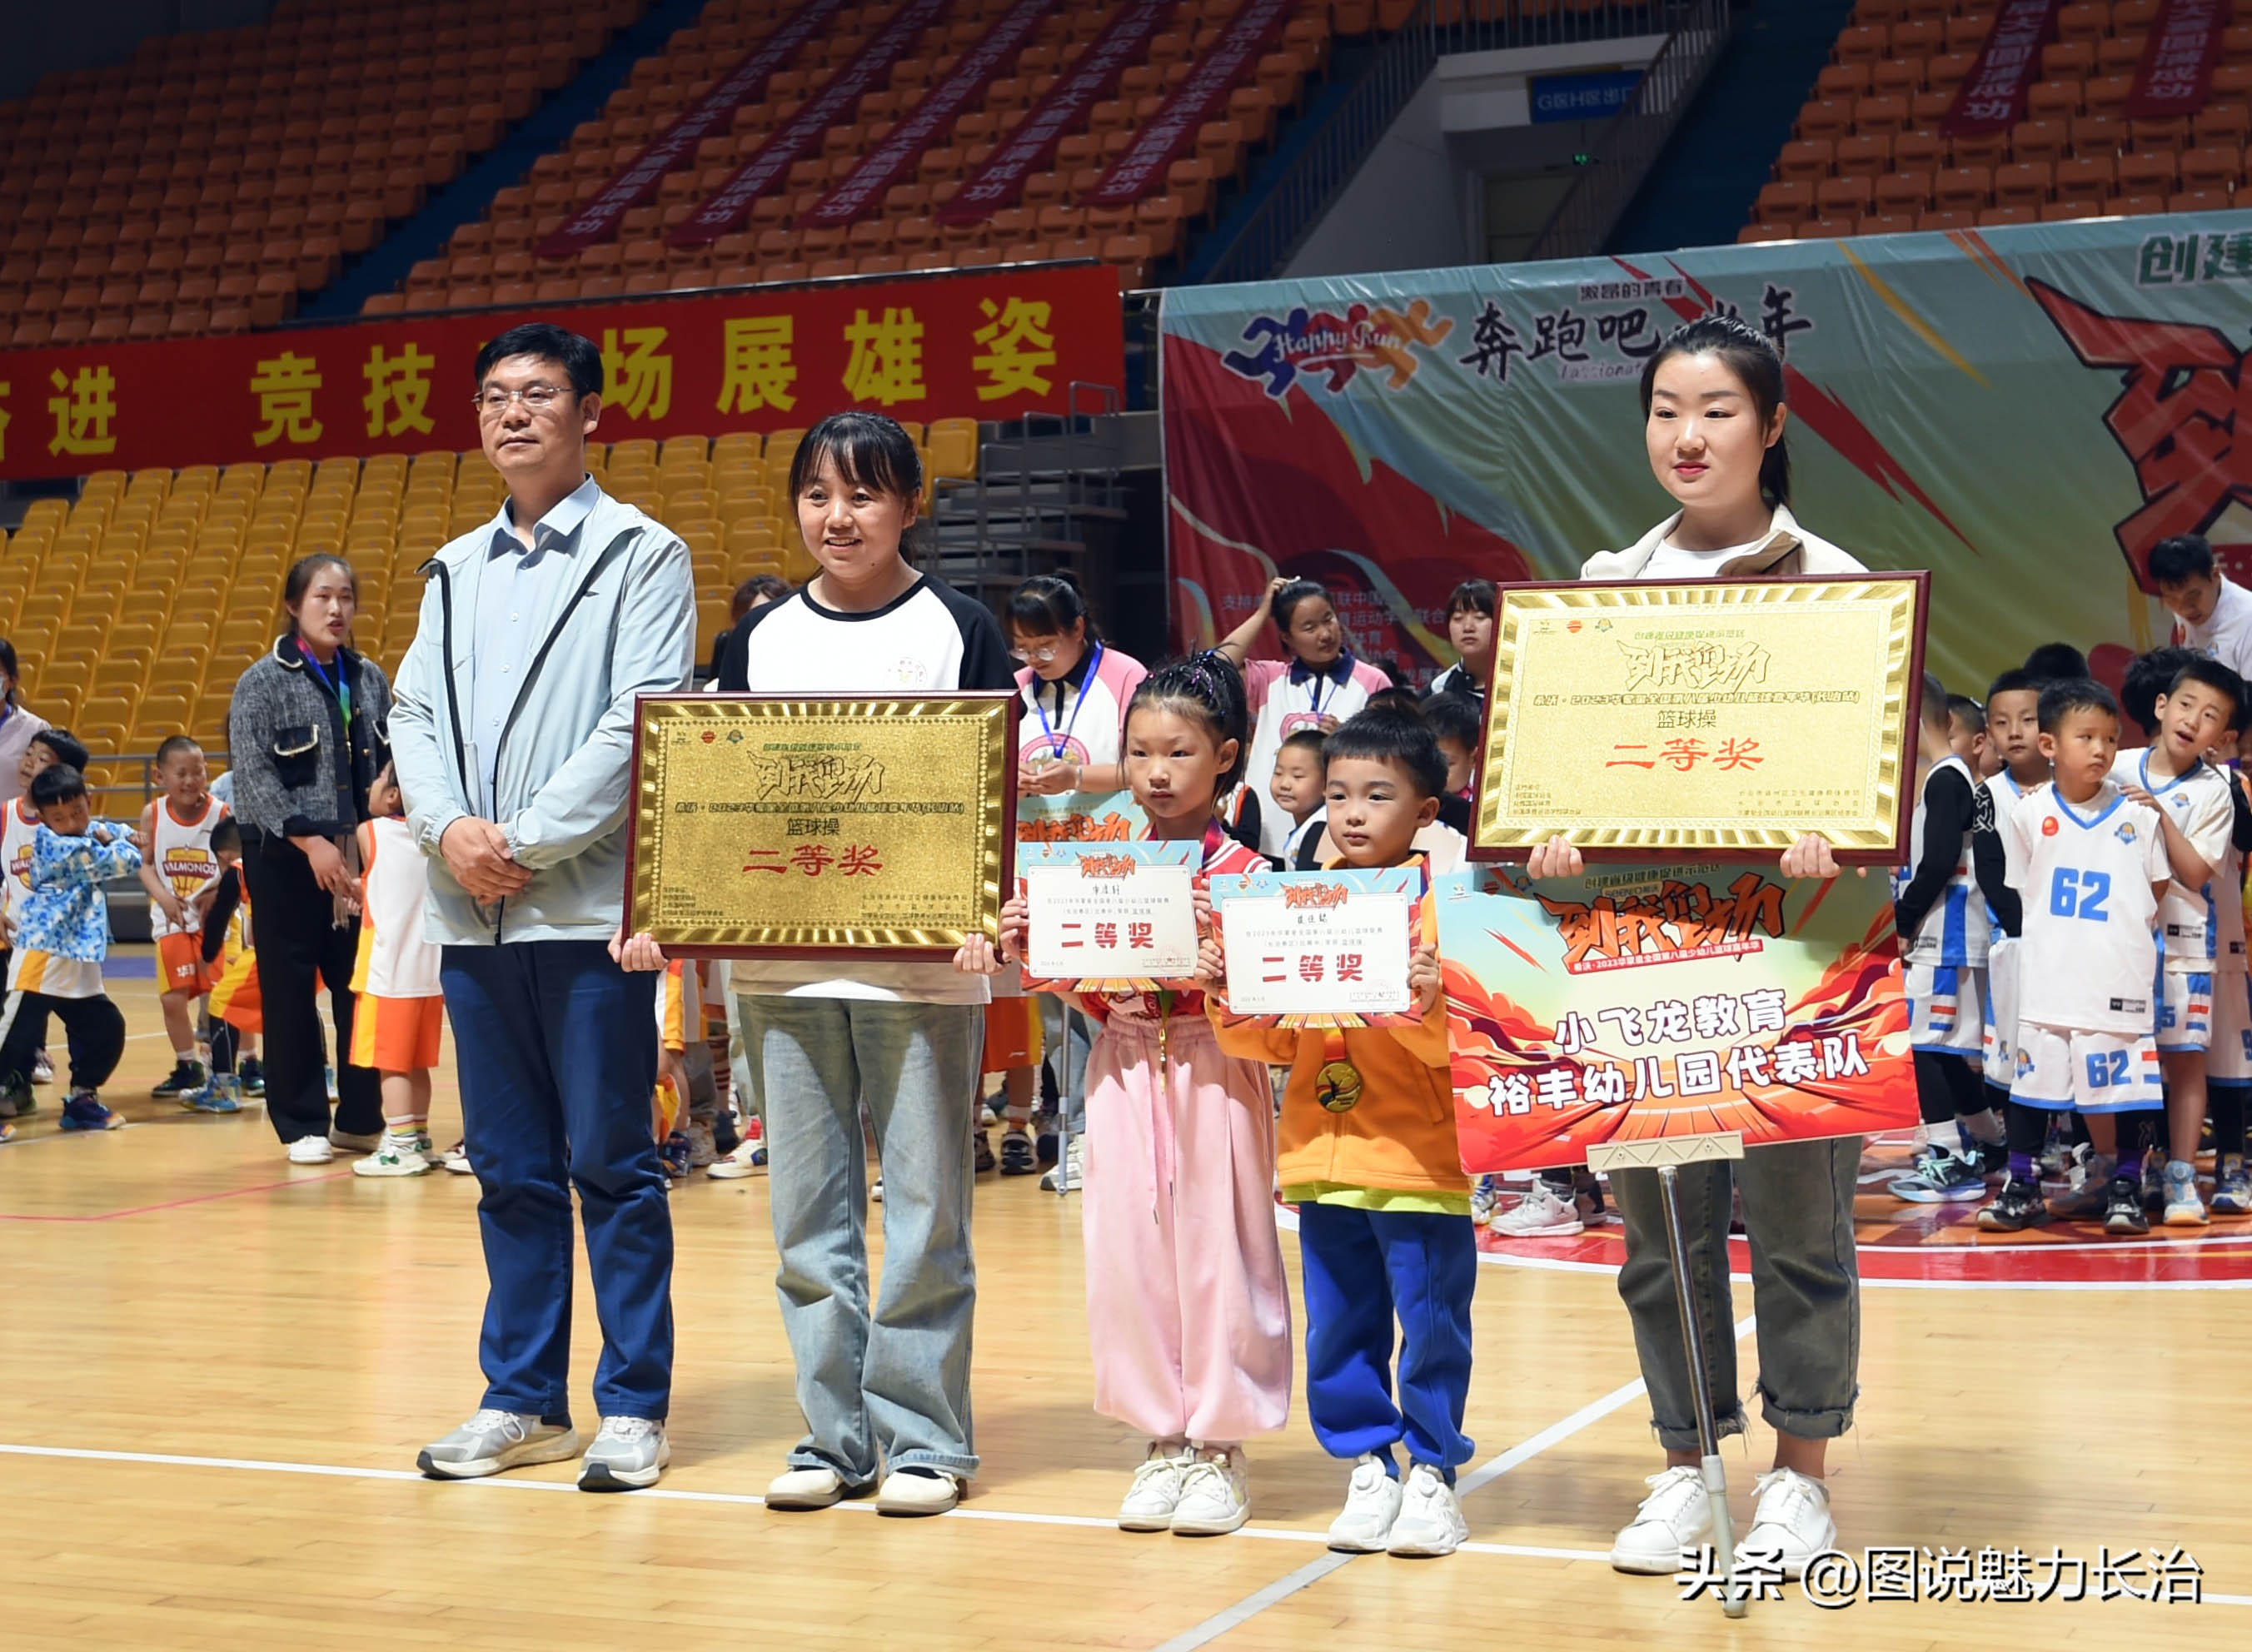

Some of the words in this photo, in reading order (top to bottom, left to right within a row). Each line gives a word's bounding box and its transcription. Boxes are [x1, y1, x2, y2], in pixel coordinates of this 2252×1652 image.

[252, 296, 1056, 447] 竞技场展雄姿
[1657, 709, 1717, 729] 篮球操
[1605, 738, 1765, 772] 二等奖
[786, 817, 841, 837] 篮球操
[742, 843, 884, 878] 二等奖
[2050, 866, 2111, 922] 62
[1061, 922, 1154, 949] 二等奖
[1262, 953, 1363, 983] 二等奖
[1555, 988, 1786, 1055] 小飞龙教育
[1487, 1030, 1870, 1117] 裕丰幼儿园代表队
[2086, 1048, 2132, 1088] 62
